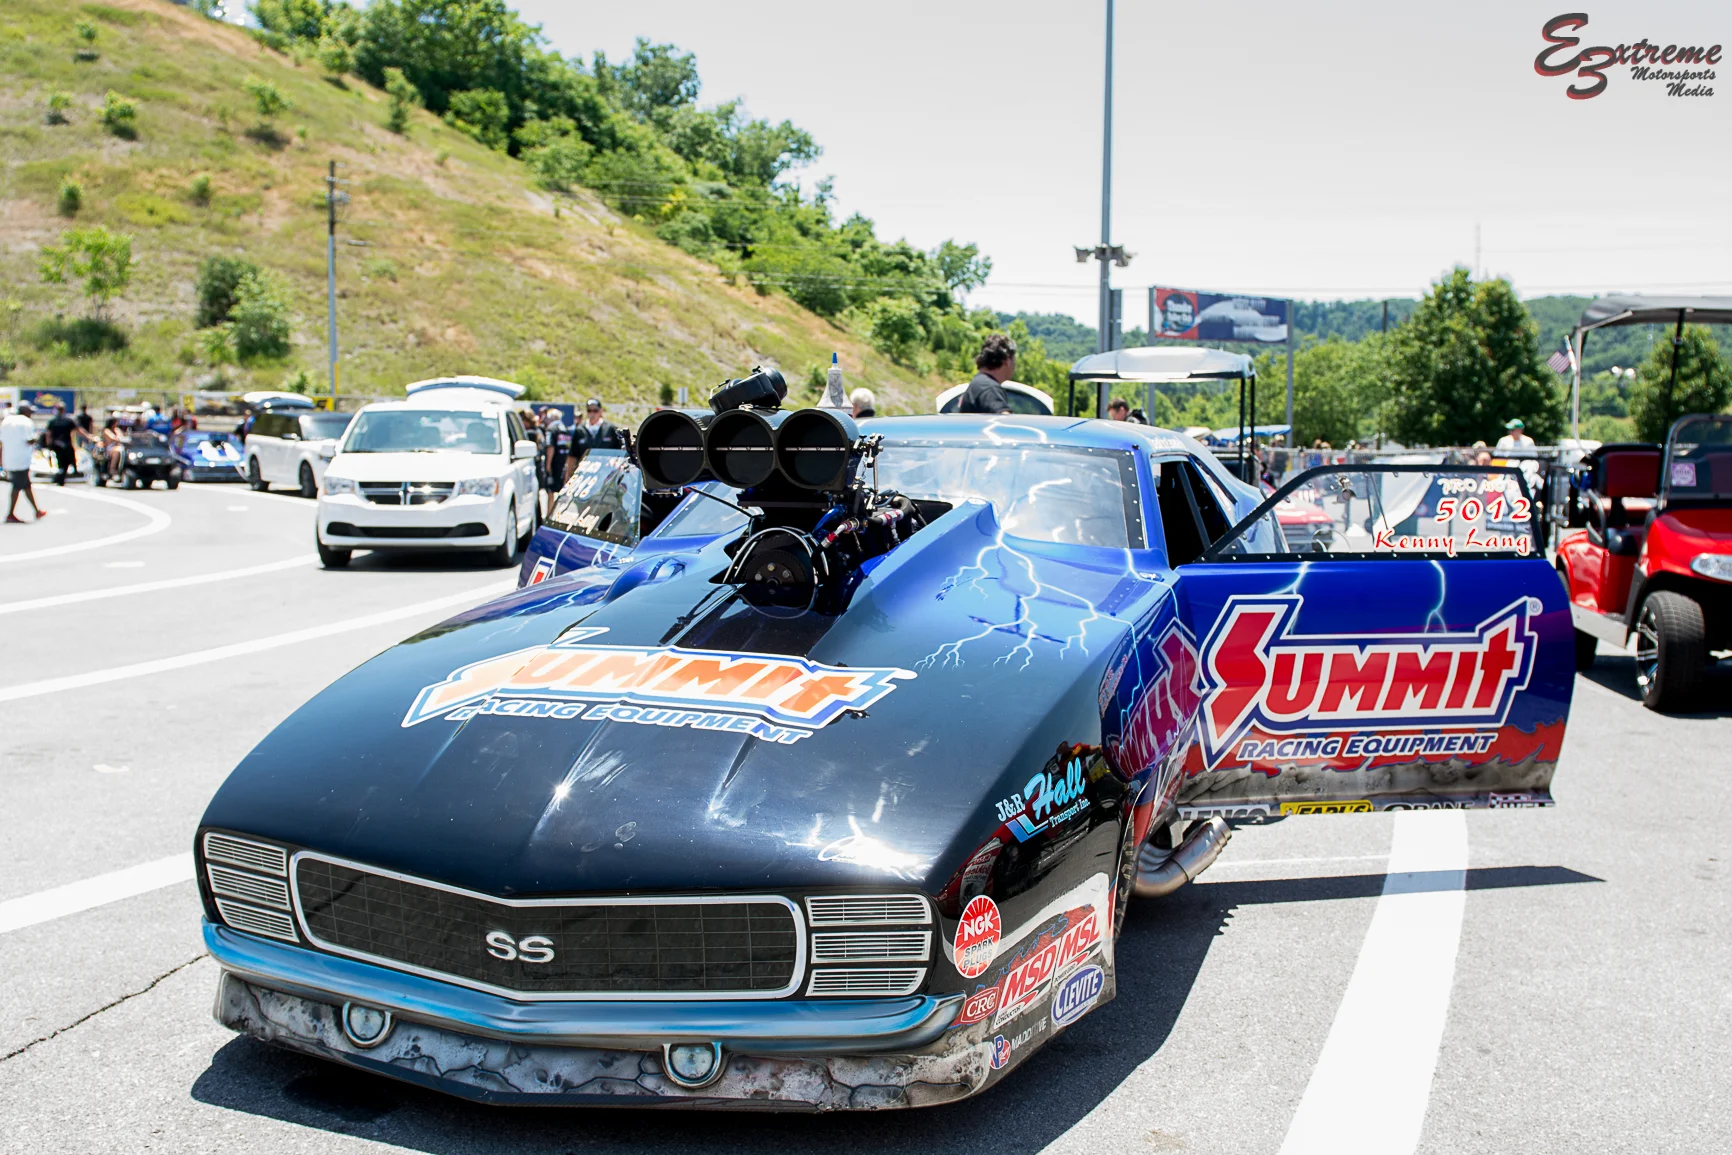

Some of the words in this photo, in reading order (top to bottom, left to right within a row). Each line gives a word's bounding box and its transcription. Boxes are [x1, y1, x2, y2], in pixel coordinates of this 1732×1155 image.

[1437, 477, 1478, 495] PRO
[1434, 497, 1532, 523] 5012
[1375, 528, 1455, 558] Kenny
[1464, 526, 1531, 555] Lang
[444, 698, 588, 722] RACING
[581, 703, 814, 745] EQUIPMENT
[1237, 736, 1340, 762] RACING
[1344, 733, 1498, 757] EQUIPMENT
[995, 793, 1026, 822] J&R
[1023, 756, 1086, 821] Hall
[963, 909, 994, 941] NGK
[486, 931, 555, 963] SS
[964, 935, 995, 958] SPARK
[1001, 943, 1057, 1009] MSD
[966, 991, 996, 1018] CRC
[1055, 969, 1100, 1019] CLEVITE
